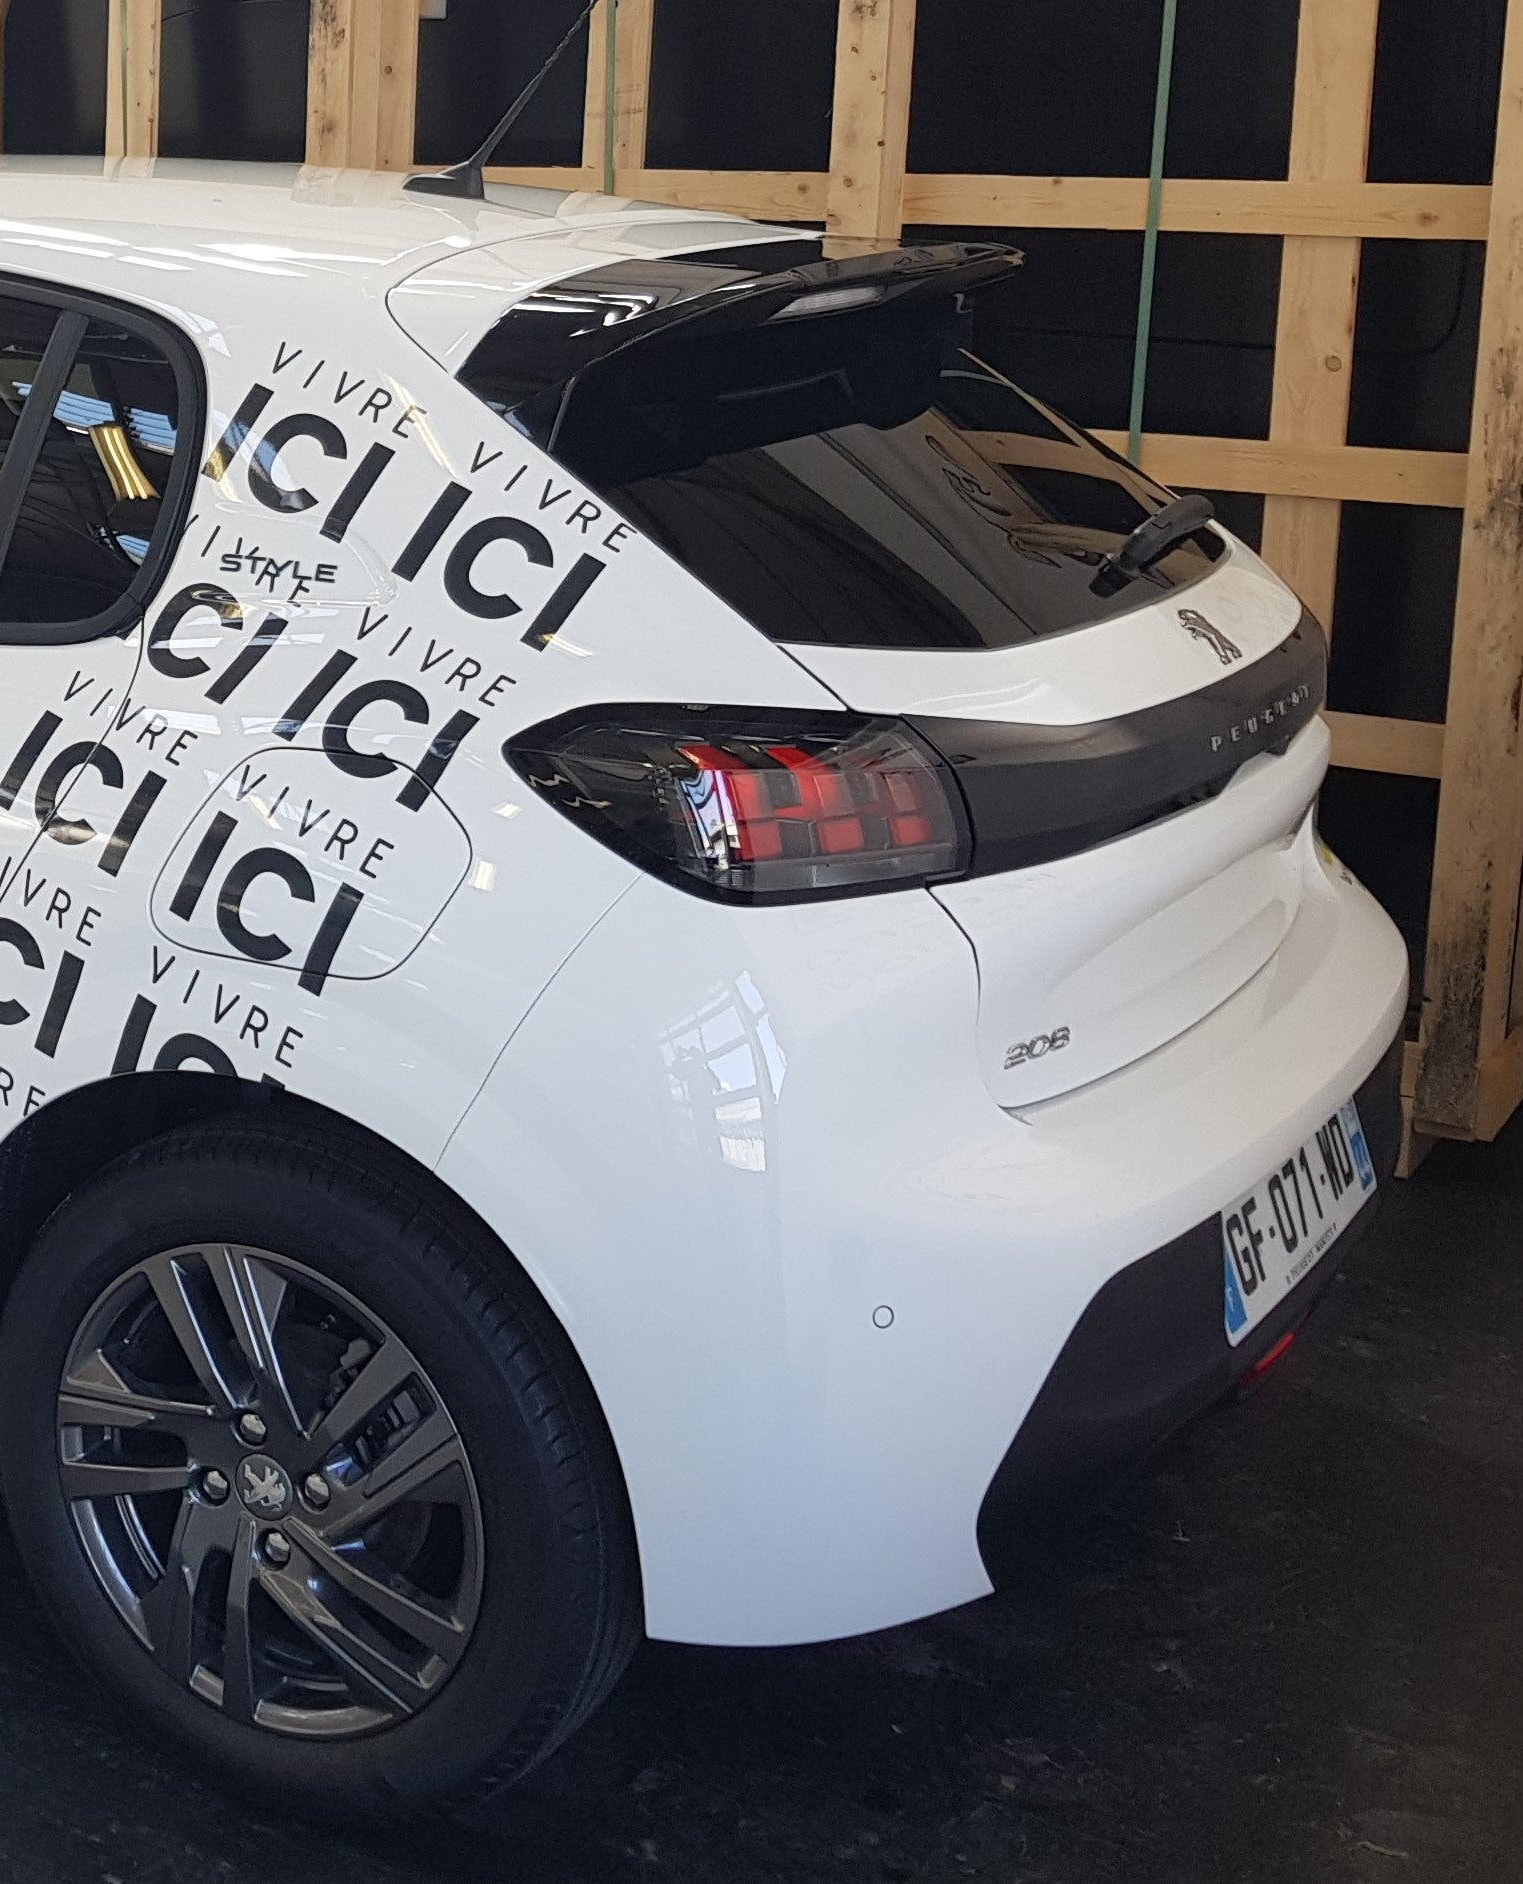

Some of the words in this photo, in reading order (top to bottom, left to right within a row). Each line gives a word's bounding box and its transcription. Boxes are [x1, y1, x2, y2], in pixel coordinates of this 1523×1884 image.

[272, 341, 427, 438] VIVRE
[201, 383, 396, 543] ICI
[470, 442, 637, 552] VIVRE
[220, 554, 338, 583] STYLE
[391, 481, 607, 652] ICI
[147, 583, 288, 705] CI
[357, 607, 517, 707] VIVRE
[64, 671, 197, 766] VIVRE
[271, 649, 480, 812] ICI
[237, 765, 395, 879] VIVRE
[169, 810, 364, 996] ICI
[153, 946, 303, 1068] VIVRE
[1004, 1026, 1070, 1070] 208
[1225, 1113, 1355, 1297] GF-071-WD
